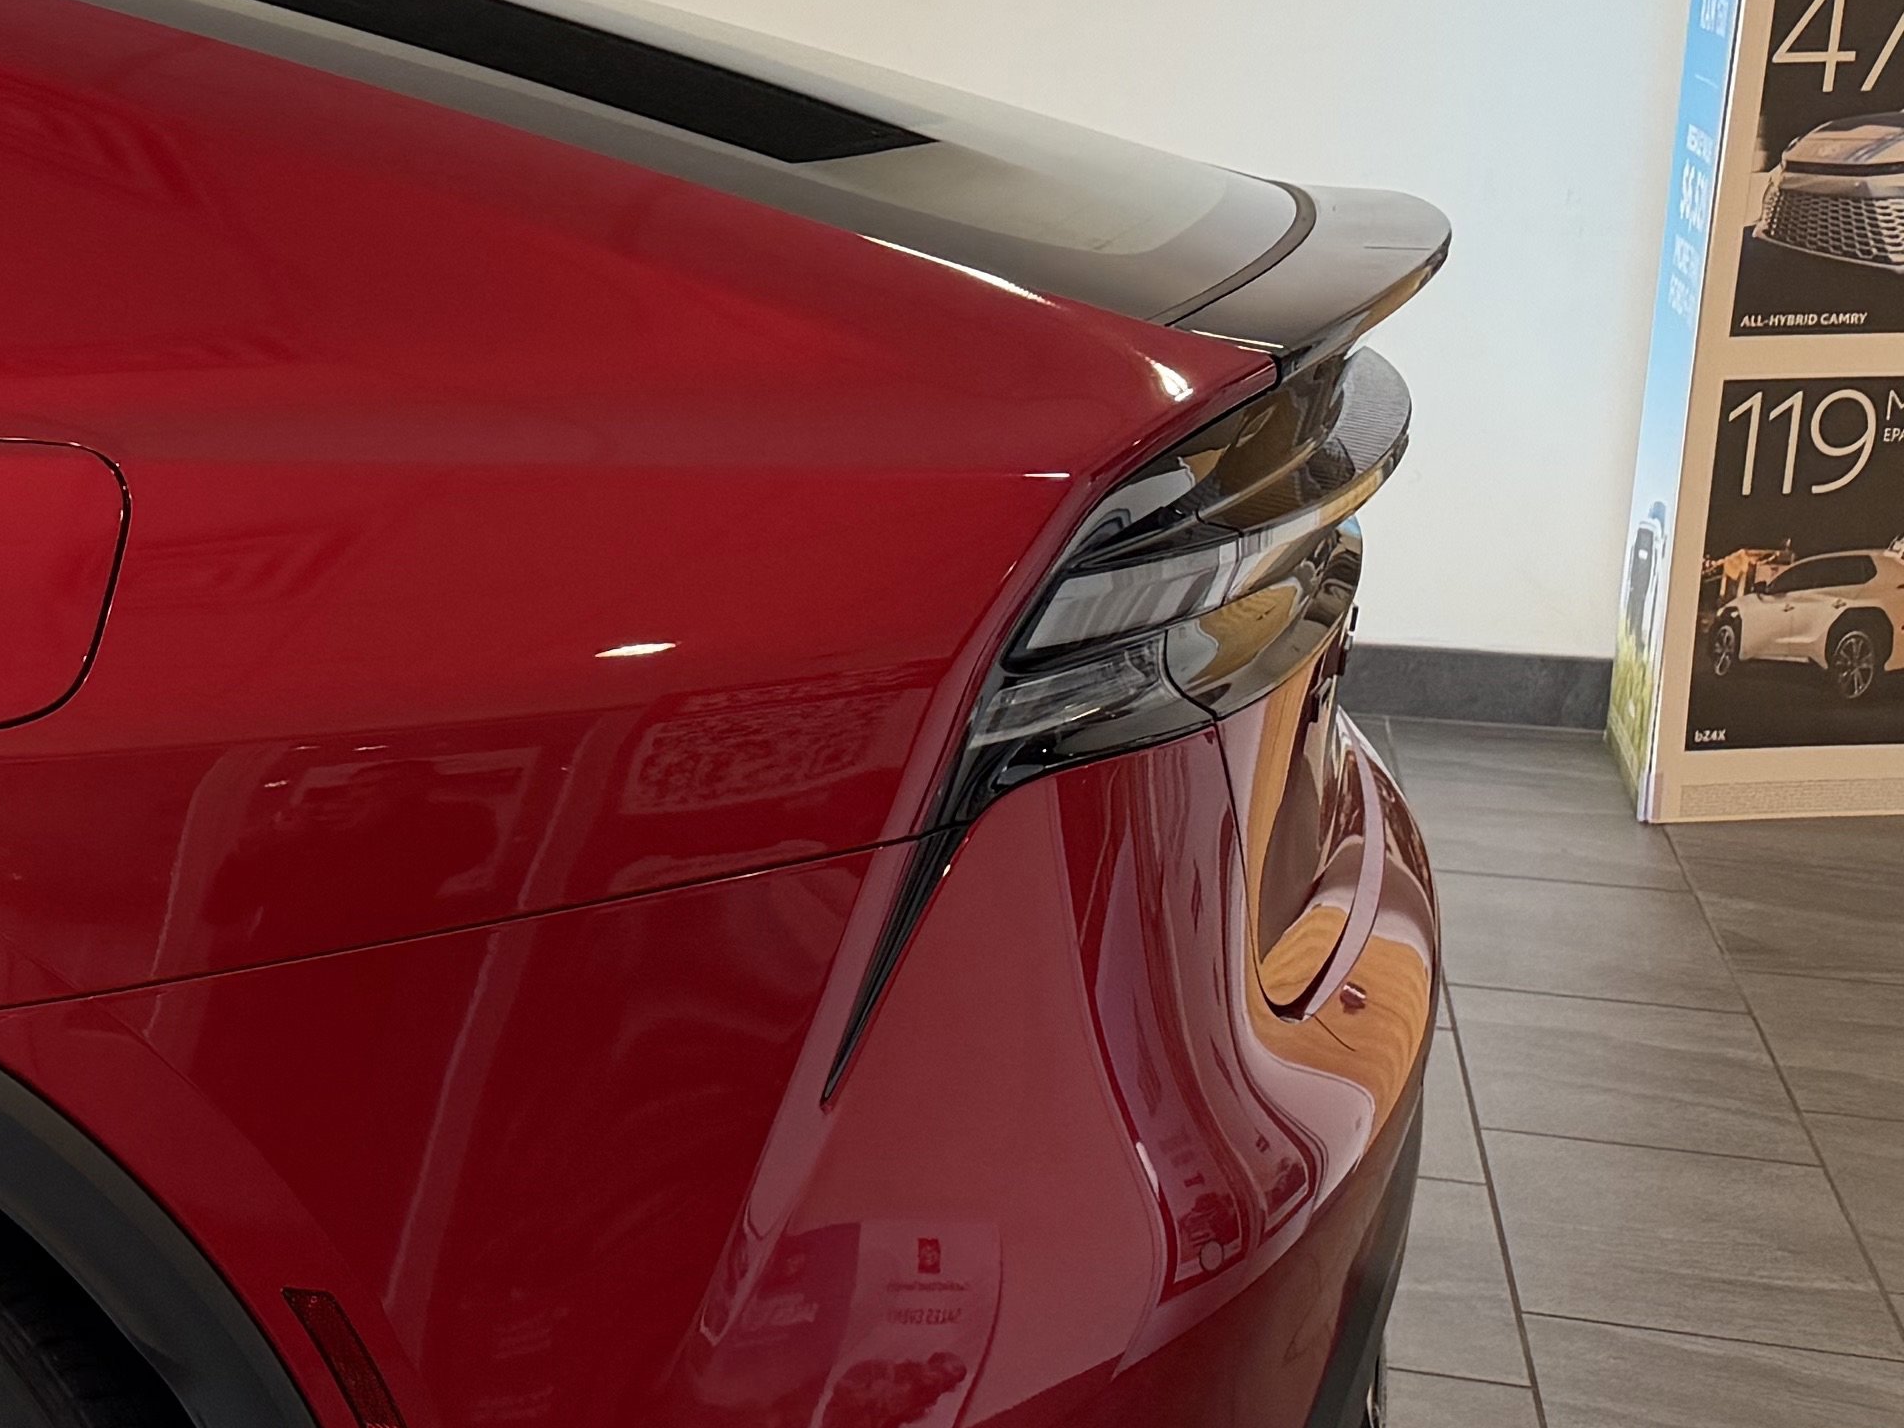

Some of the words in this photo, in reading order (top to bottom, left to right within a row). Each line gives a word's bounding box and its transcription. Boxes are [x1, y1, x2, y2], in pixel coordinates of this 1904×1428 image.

[1740, 313, 1817, 328] ALL-HYBRID
[1819, 312, 1868, 325] CAMRY
[1728, 389, 1877, 496] 119
[1695, 729, 1726, 743] bZ4X
